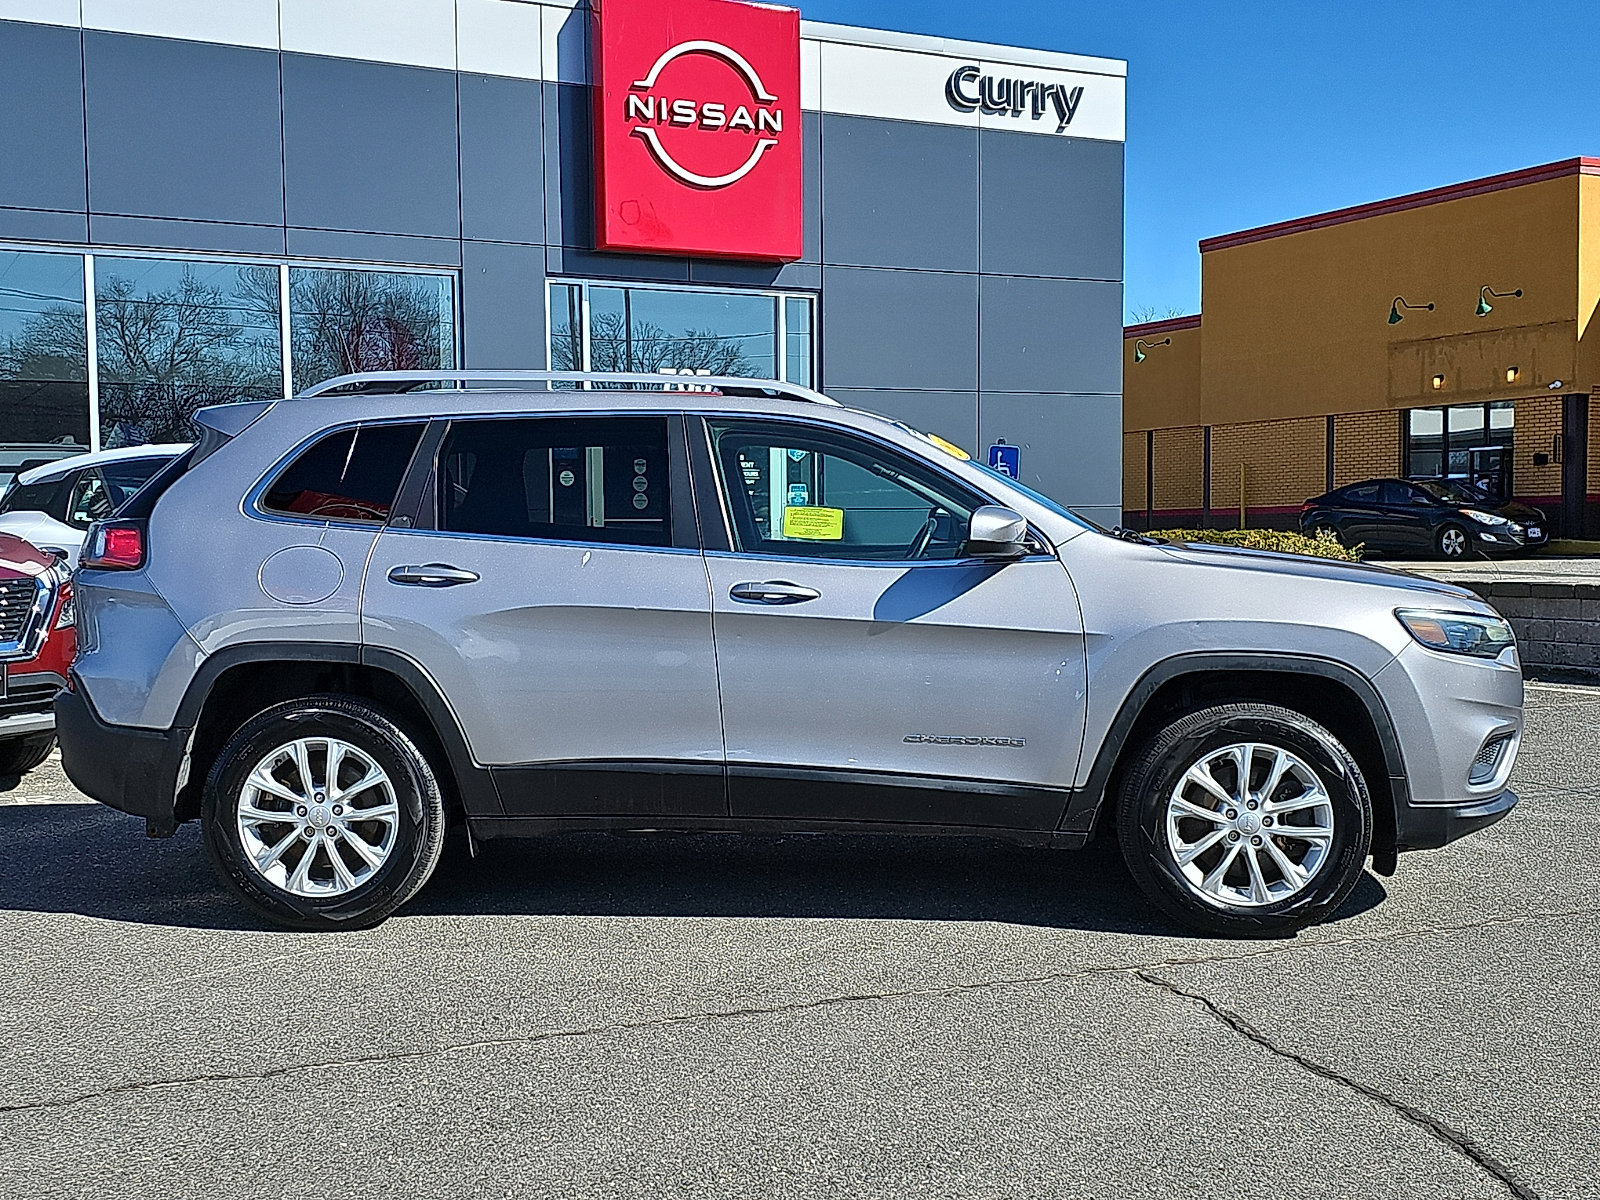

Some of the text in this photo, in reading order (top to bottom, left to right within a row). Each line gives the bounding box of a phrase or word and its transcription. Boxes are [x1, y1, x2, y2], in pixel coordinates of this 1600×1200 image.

[626, 94, 783, 134] NISSAN
[945, 65, 1085, 132] Curry
[902, 734, 1027, 749] CHEROKEE
